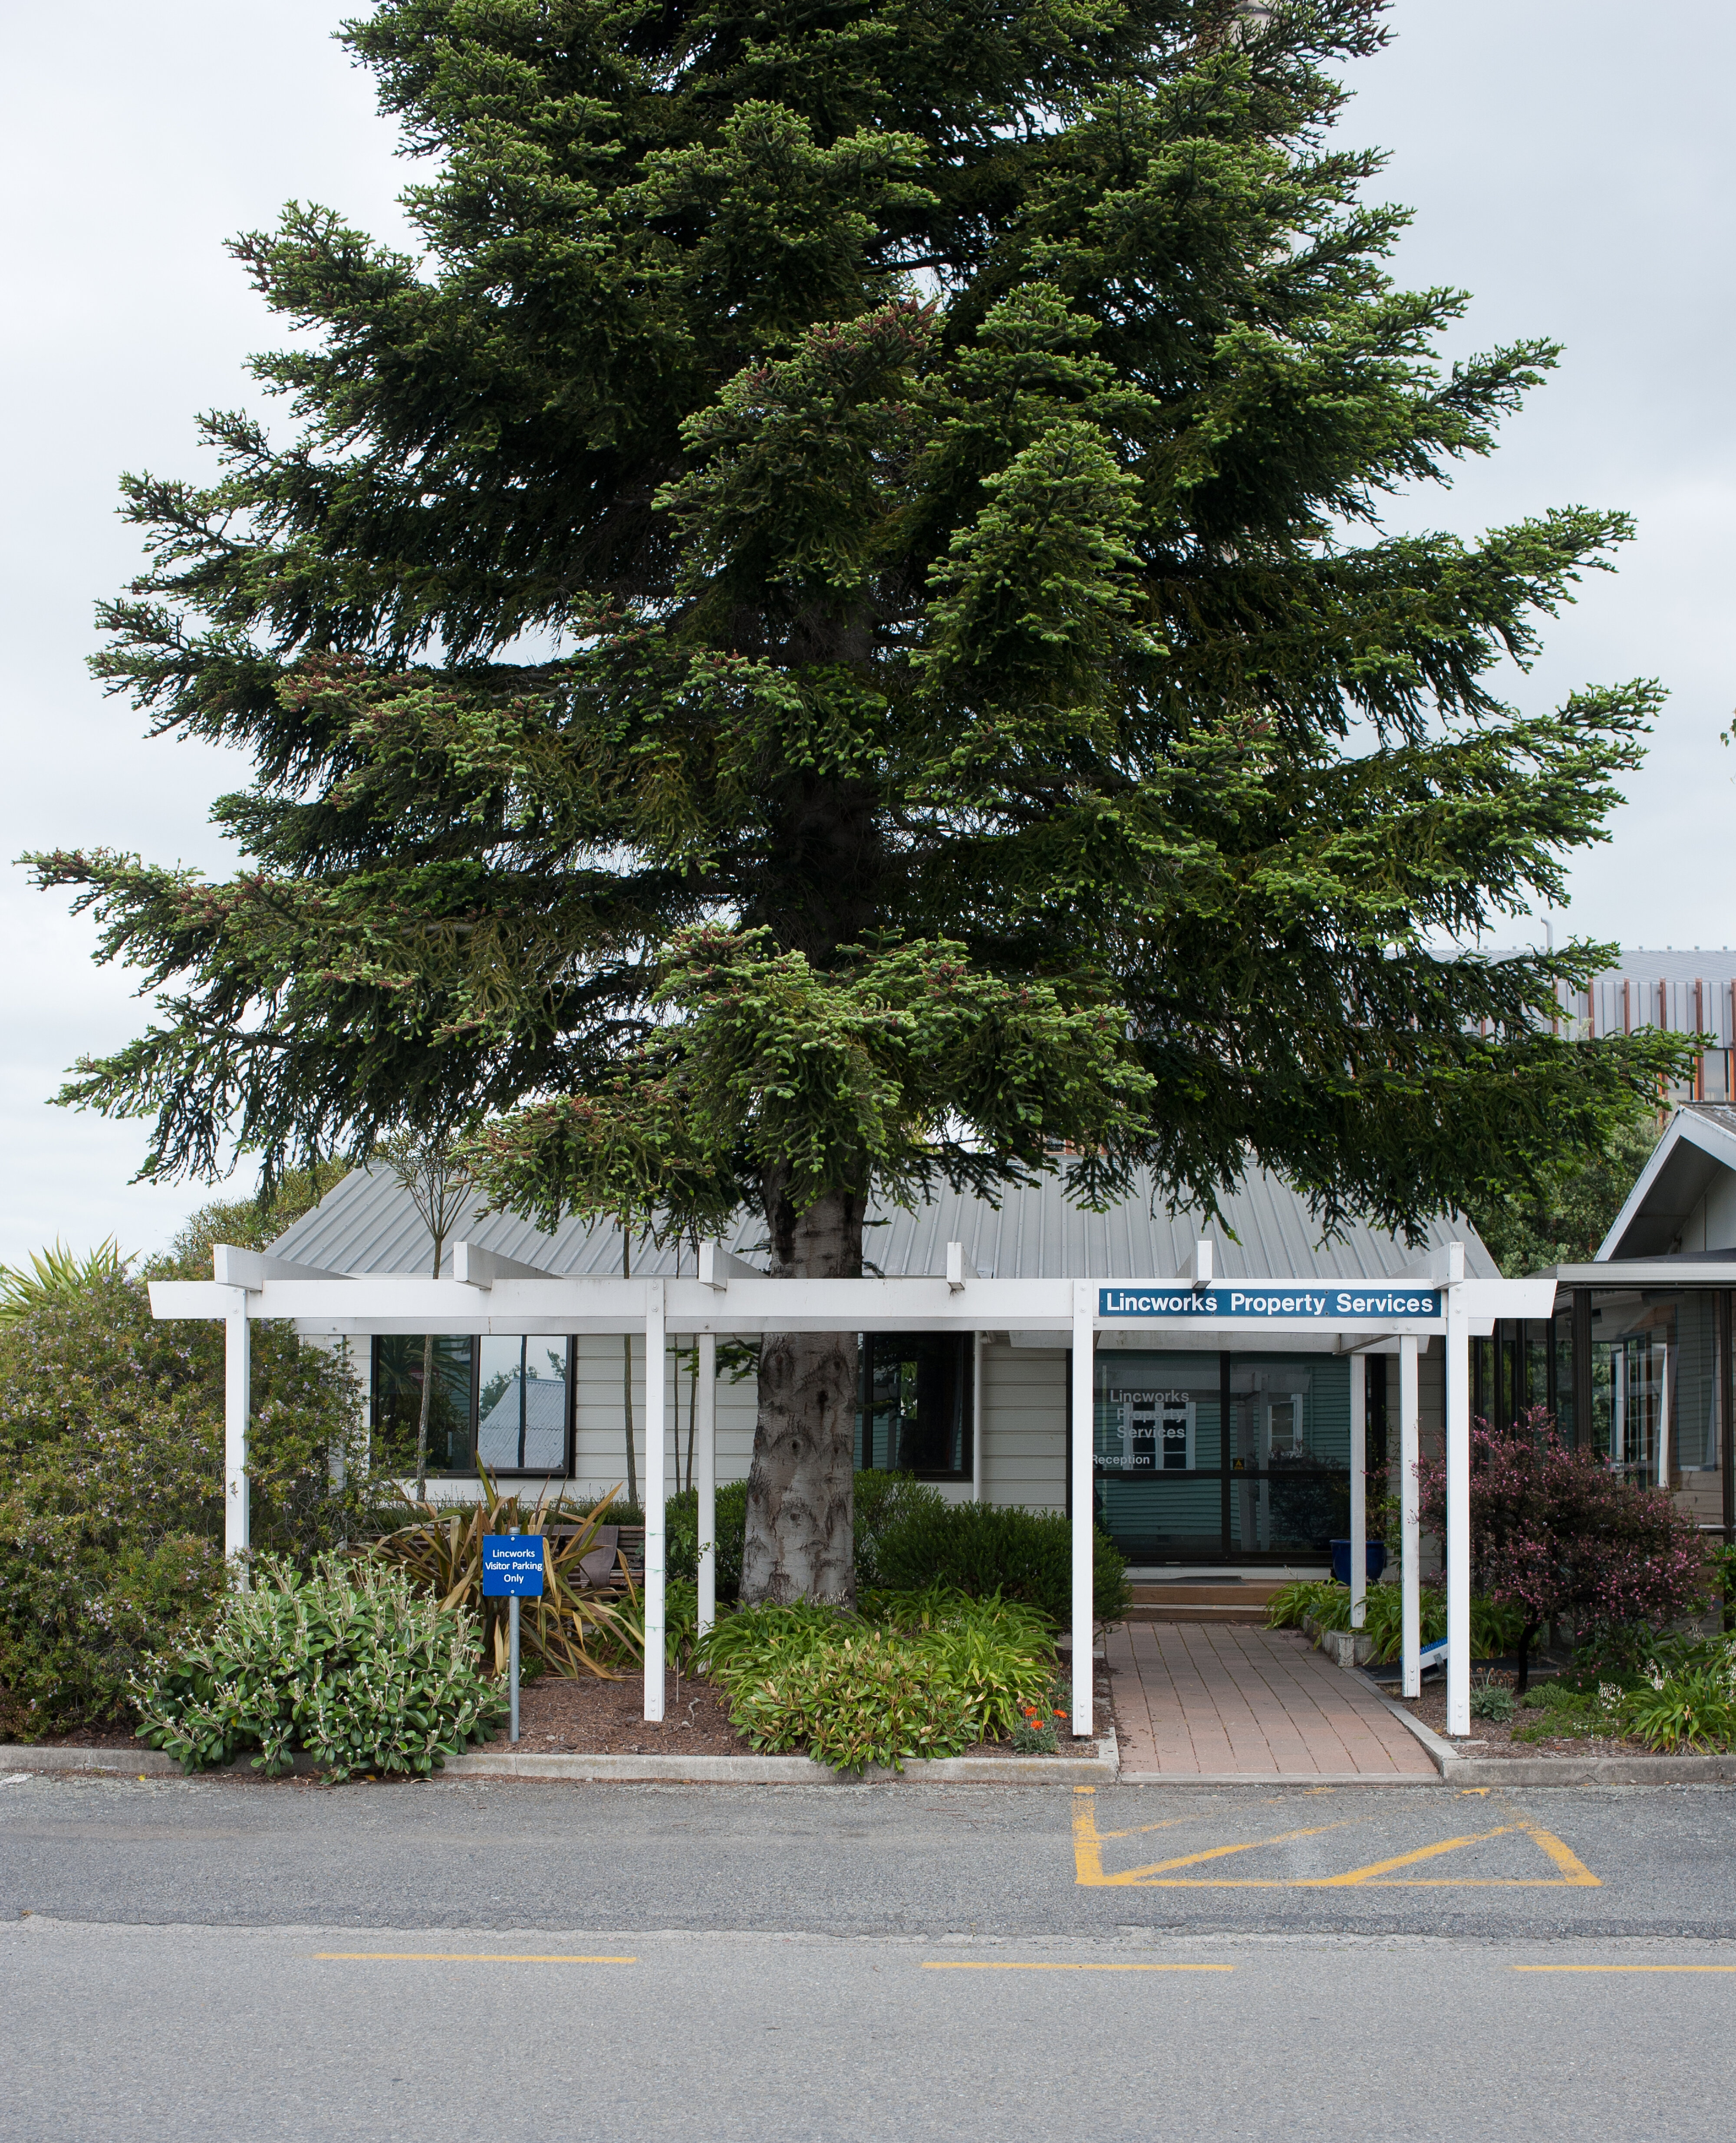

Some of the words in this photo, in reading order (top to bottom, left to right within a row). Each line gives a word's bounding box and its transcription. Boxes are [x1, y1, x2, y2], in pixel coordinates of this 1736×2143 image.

[1107, 1292, 1217, 1311] Lincworks
[1231, 1293, 1325, 1315] Property
[1336, 1293, 1433, 1312] Services
[1110, 1389, 1189, 1402] Lincworks
[1117, 1408, 1184, 1423] Property
[1117, 1425, 1185, 1439] Services
[492, 1549, 535, 1557] Lincworks
[485, 1561, 511, 1570] Visitor
[512, 1561, 543, 1571] Parking
[504, 1574, 524, 1584] Only
